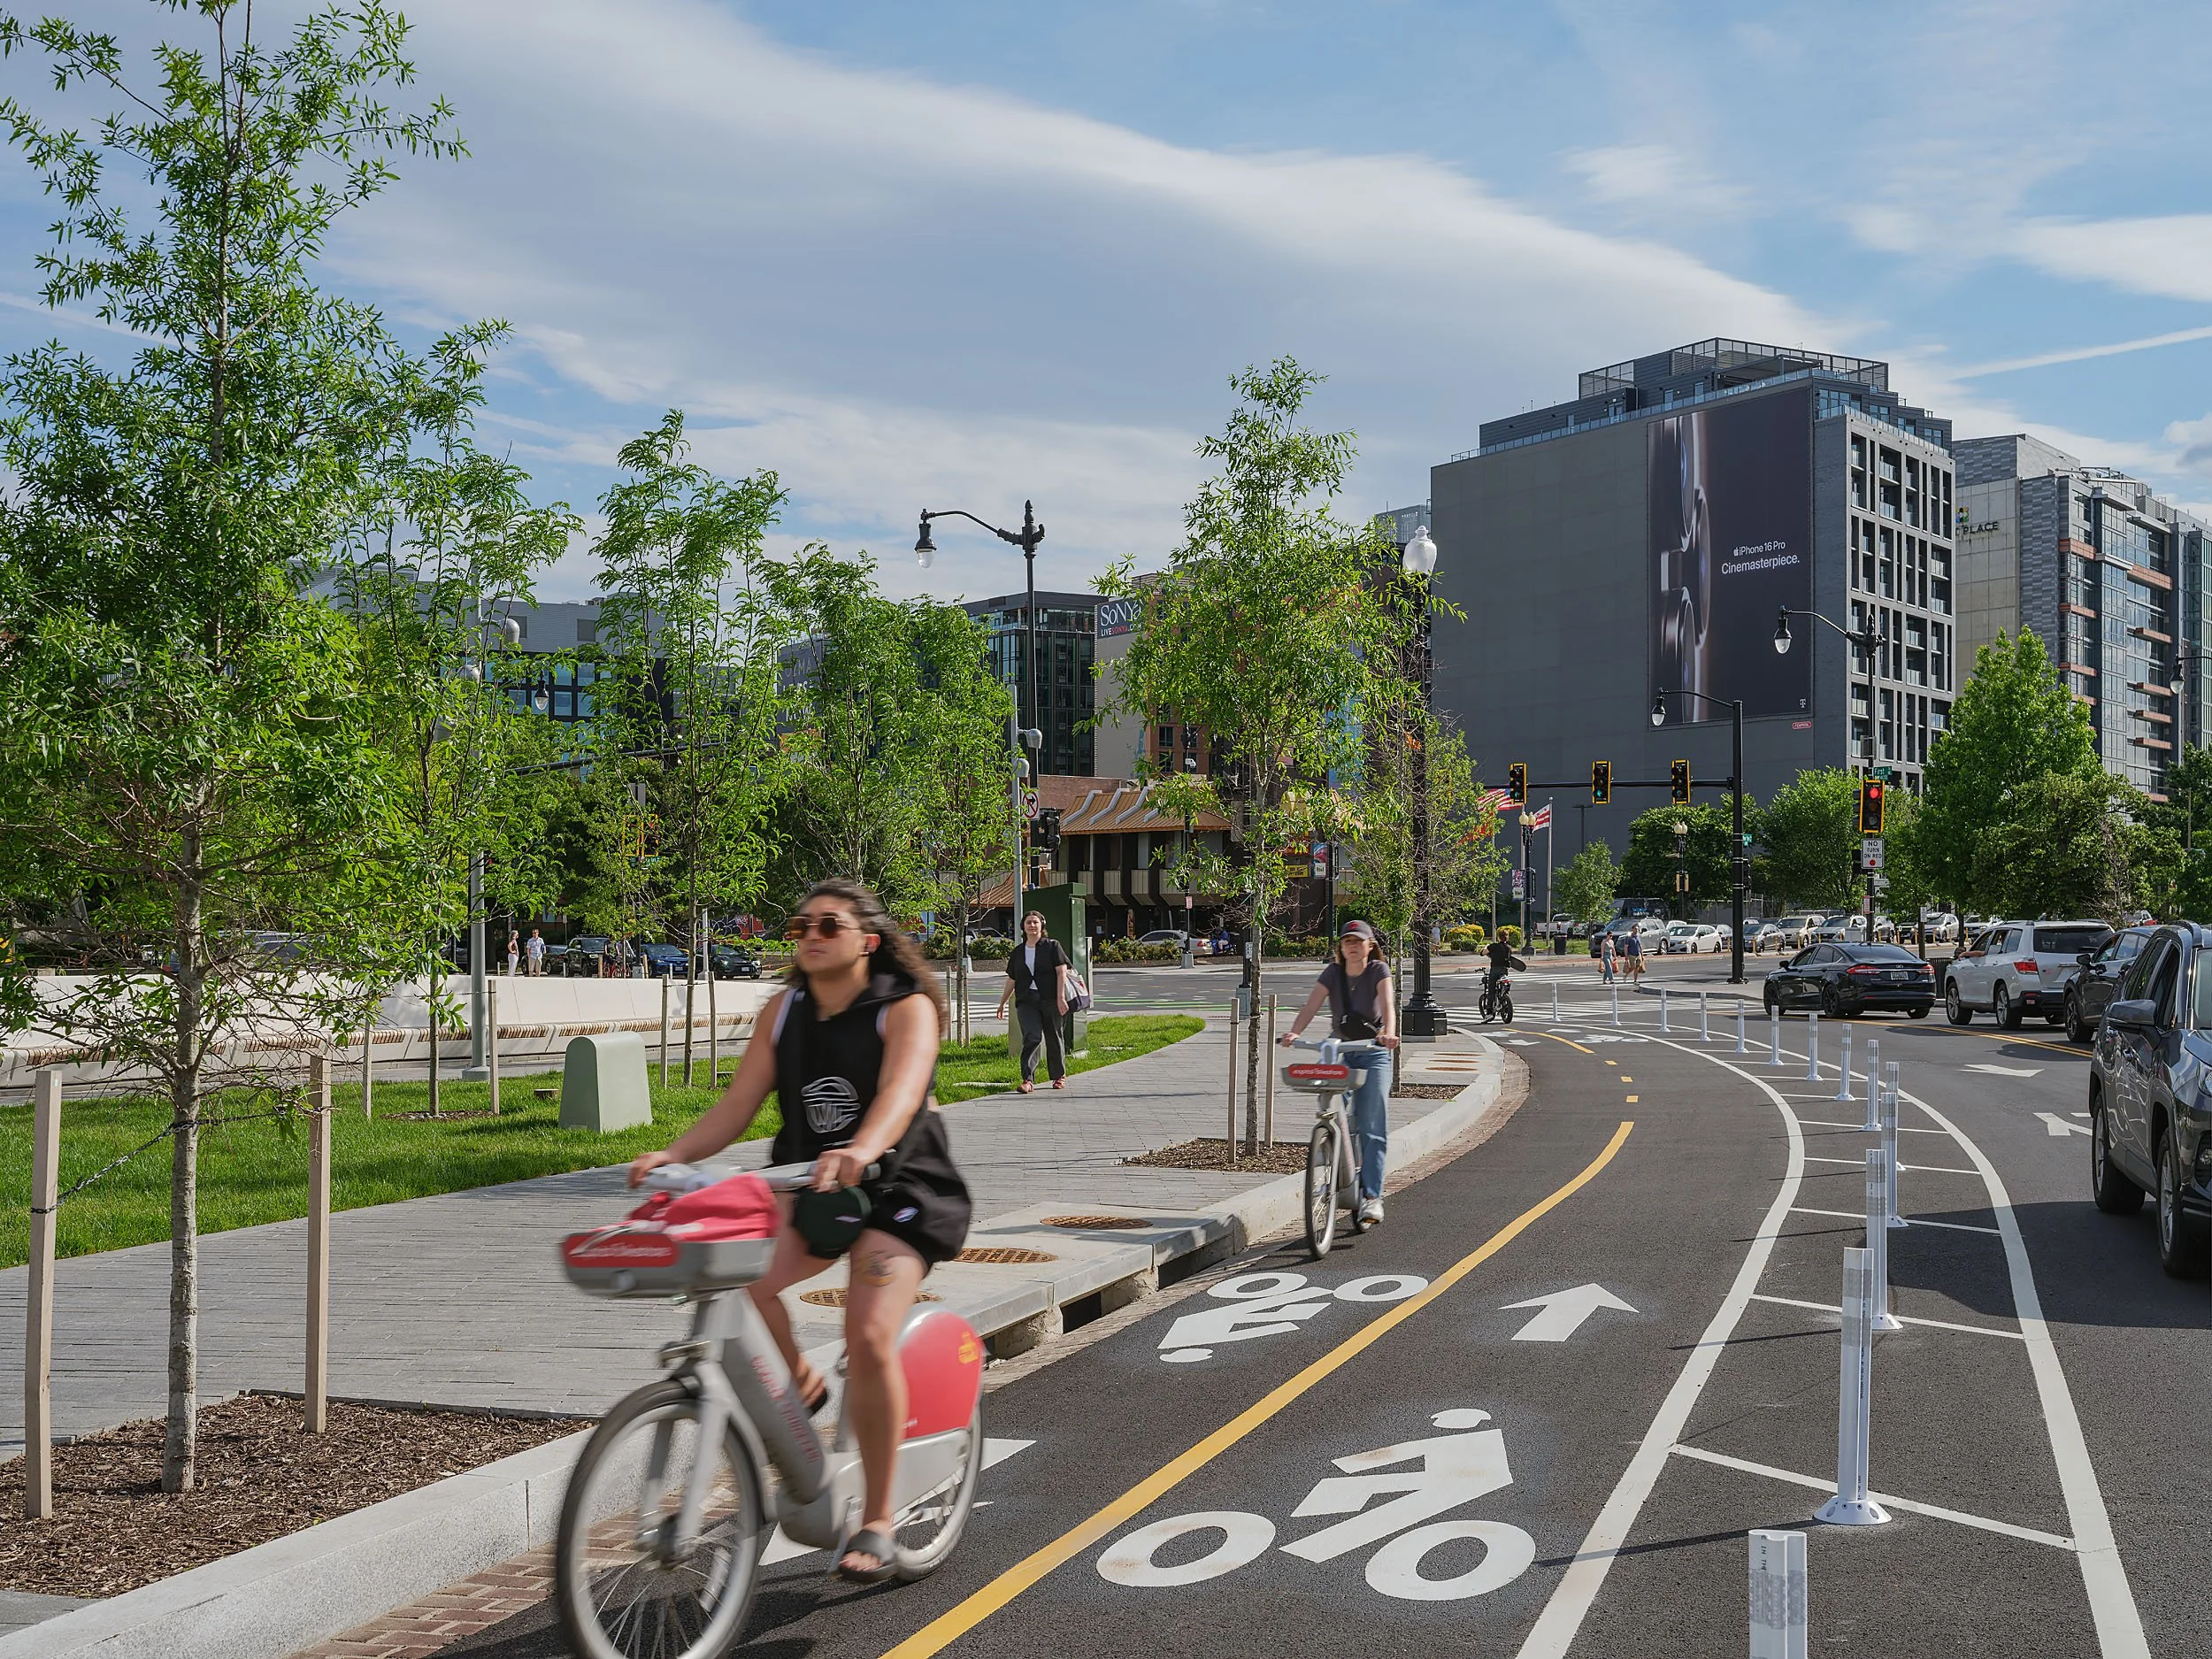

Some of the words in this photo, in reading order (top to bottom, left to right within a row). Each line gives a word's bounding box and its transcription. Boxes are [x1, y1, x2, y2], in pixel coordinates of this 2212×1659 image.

[1962, 521, 1999, 535] PLACE
[1739, 545, 1763, 557] iPhone
[1764, 541, 1772, 552] 16
[1773, 541, 1786, 550] Pro
[1721, 554, 1801, 574] Cinemasterpiece.
